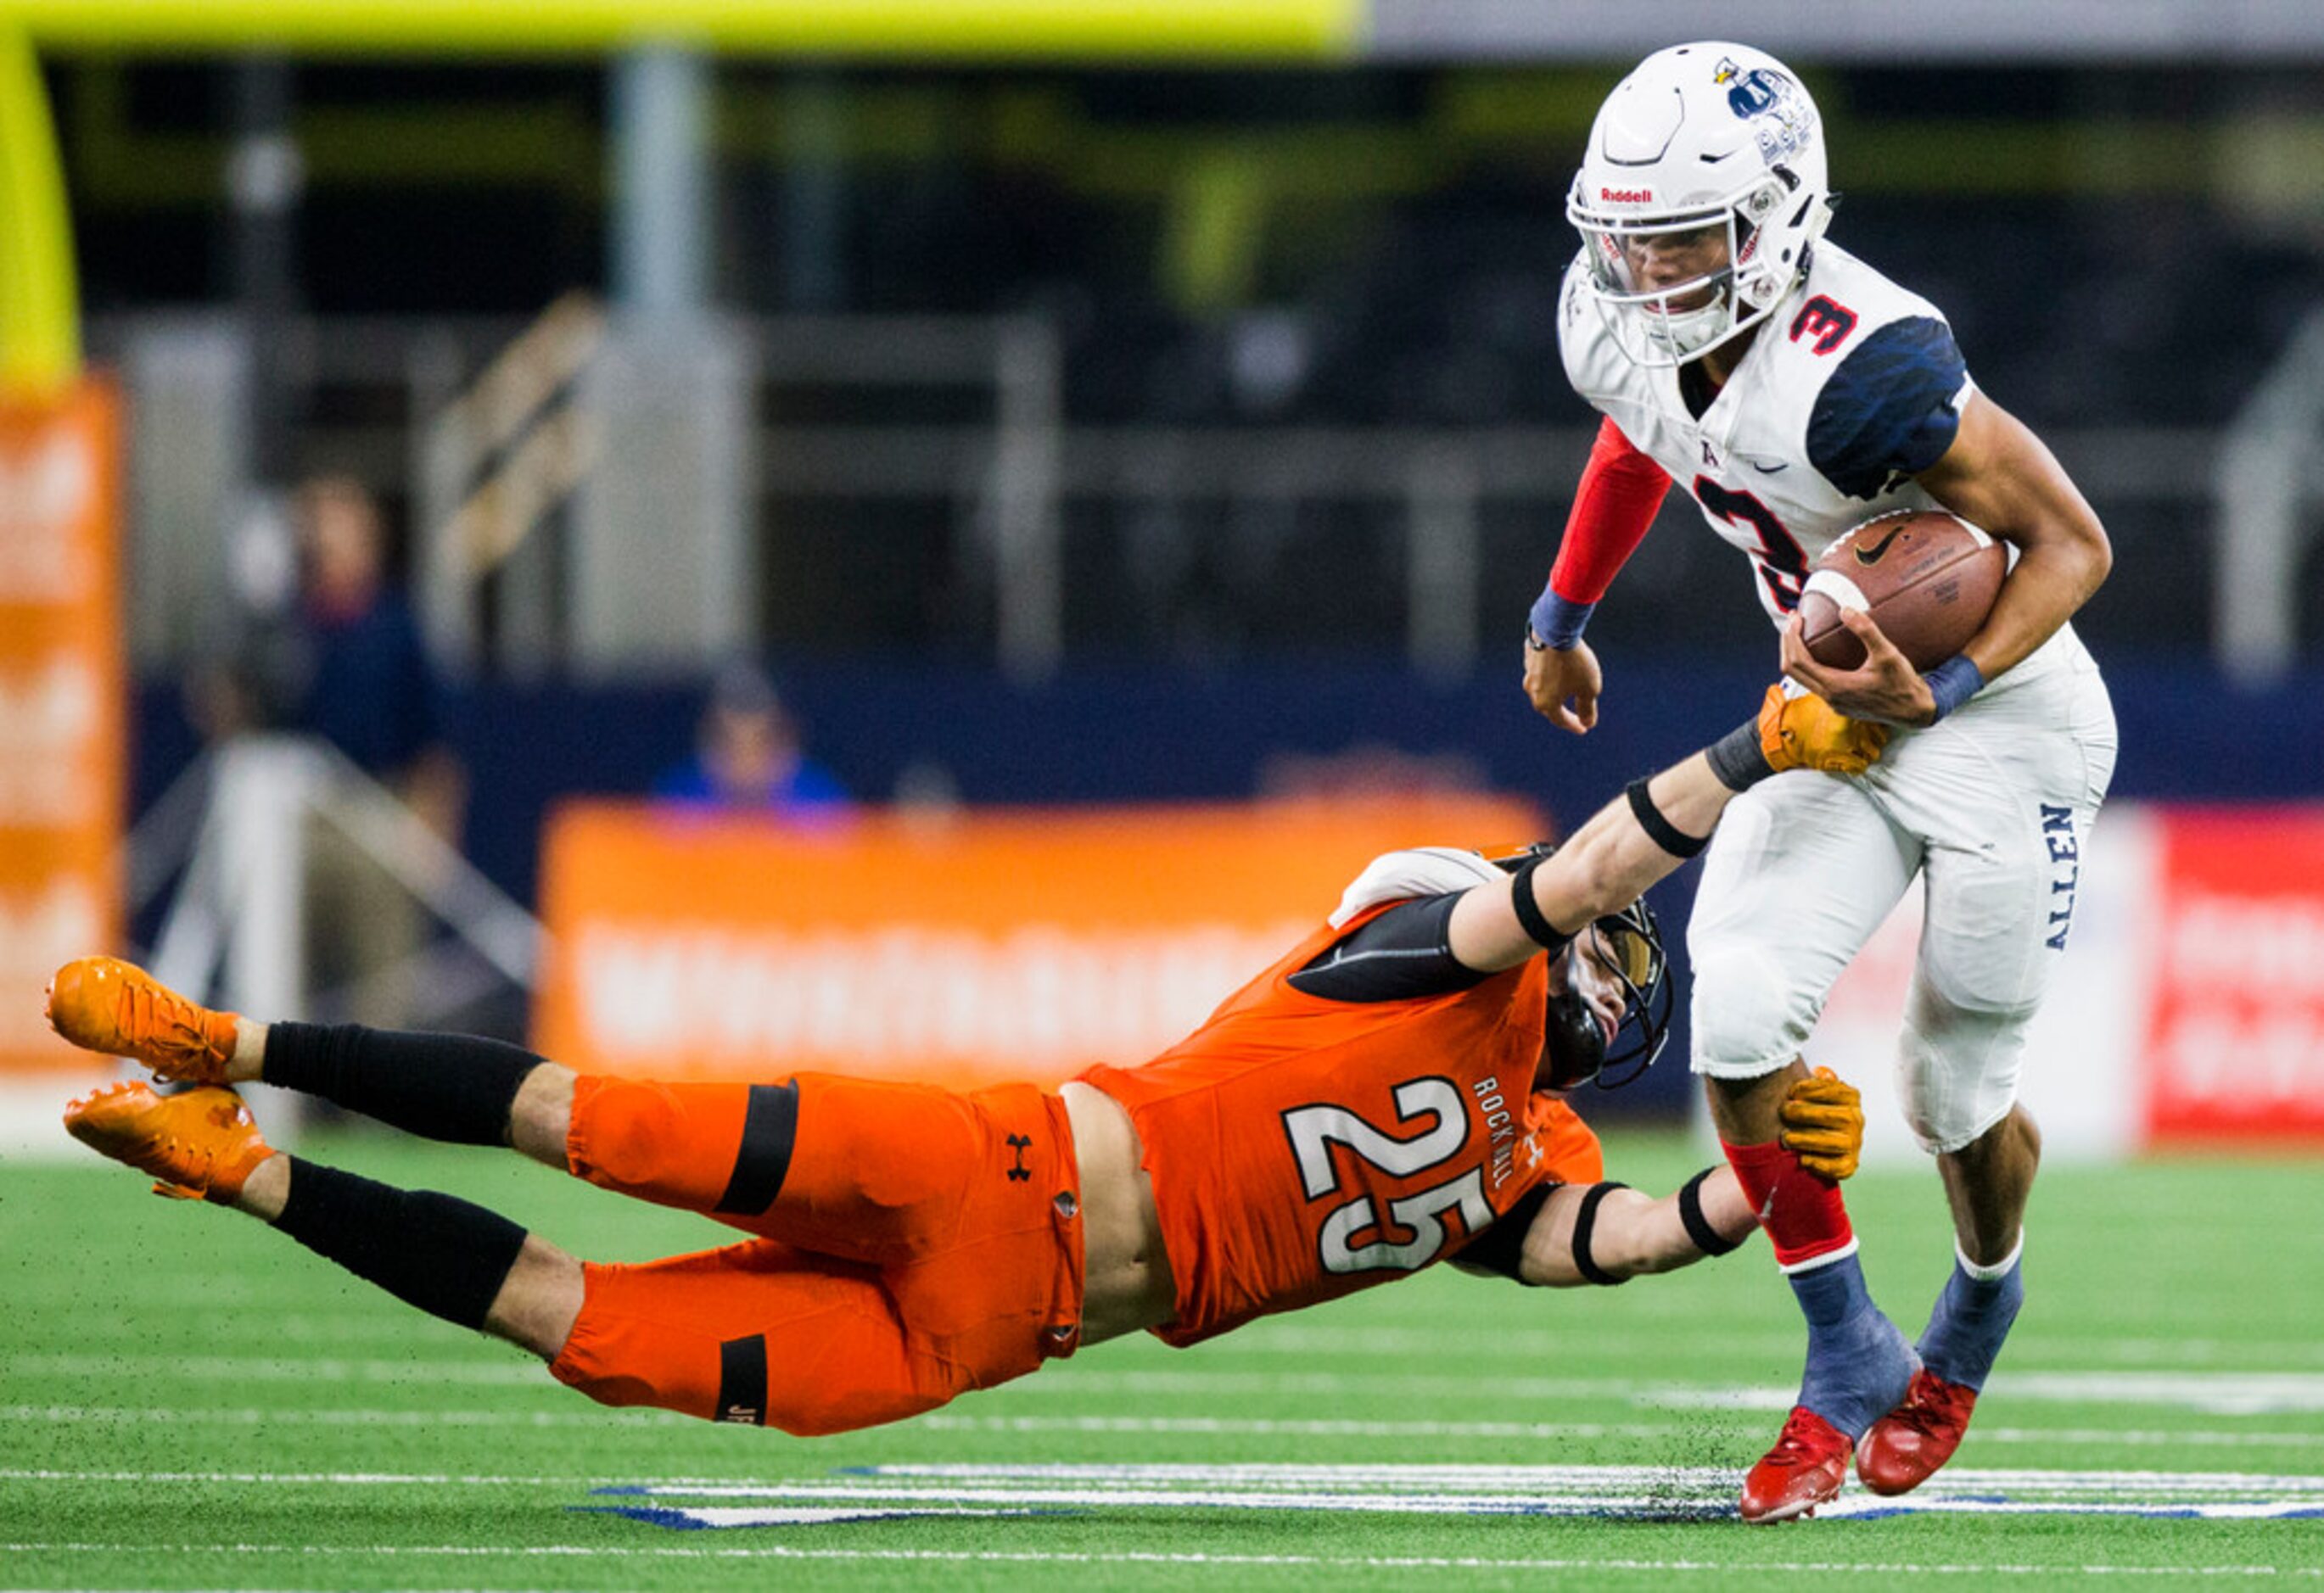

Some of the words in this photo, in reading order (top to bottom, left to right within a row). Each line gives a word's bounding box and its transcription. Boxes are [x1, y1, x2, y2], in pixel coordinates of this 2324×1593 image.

[1601, 187, 1652, 203] Riddell
[1789, 294, 1858, 356] 3
[1700, 439, 1720, 467] A
[2040, 802, 2078, 951] ALLEN
[1280, 1075, 1498, 1273] 25
